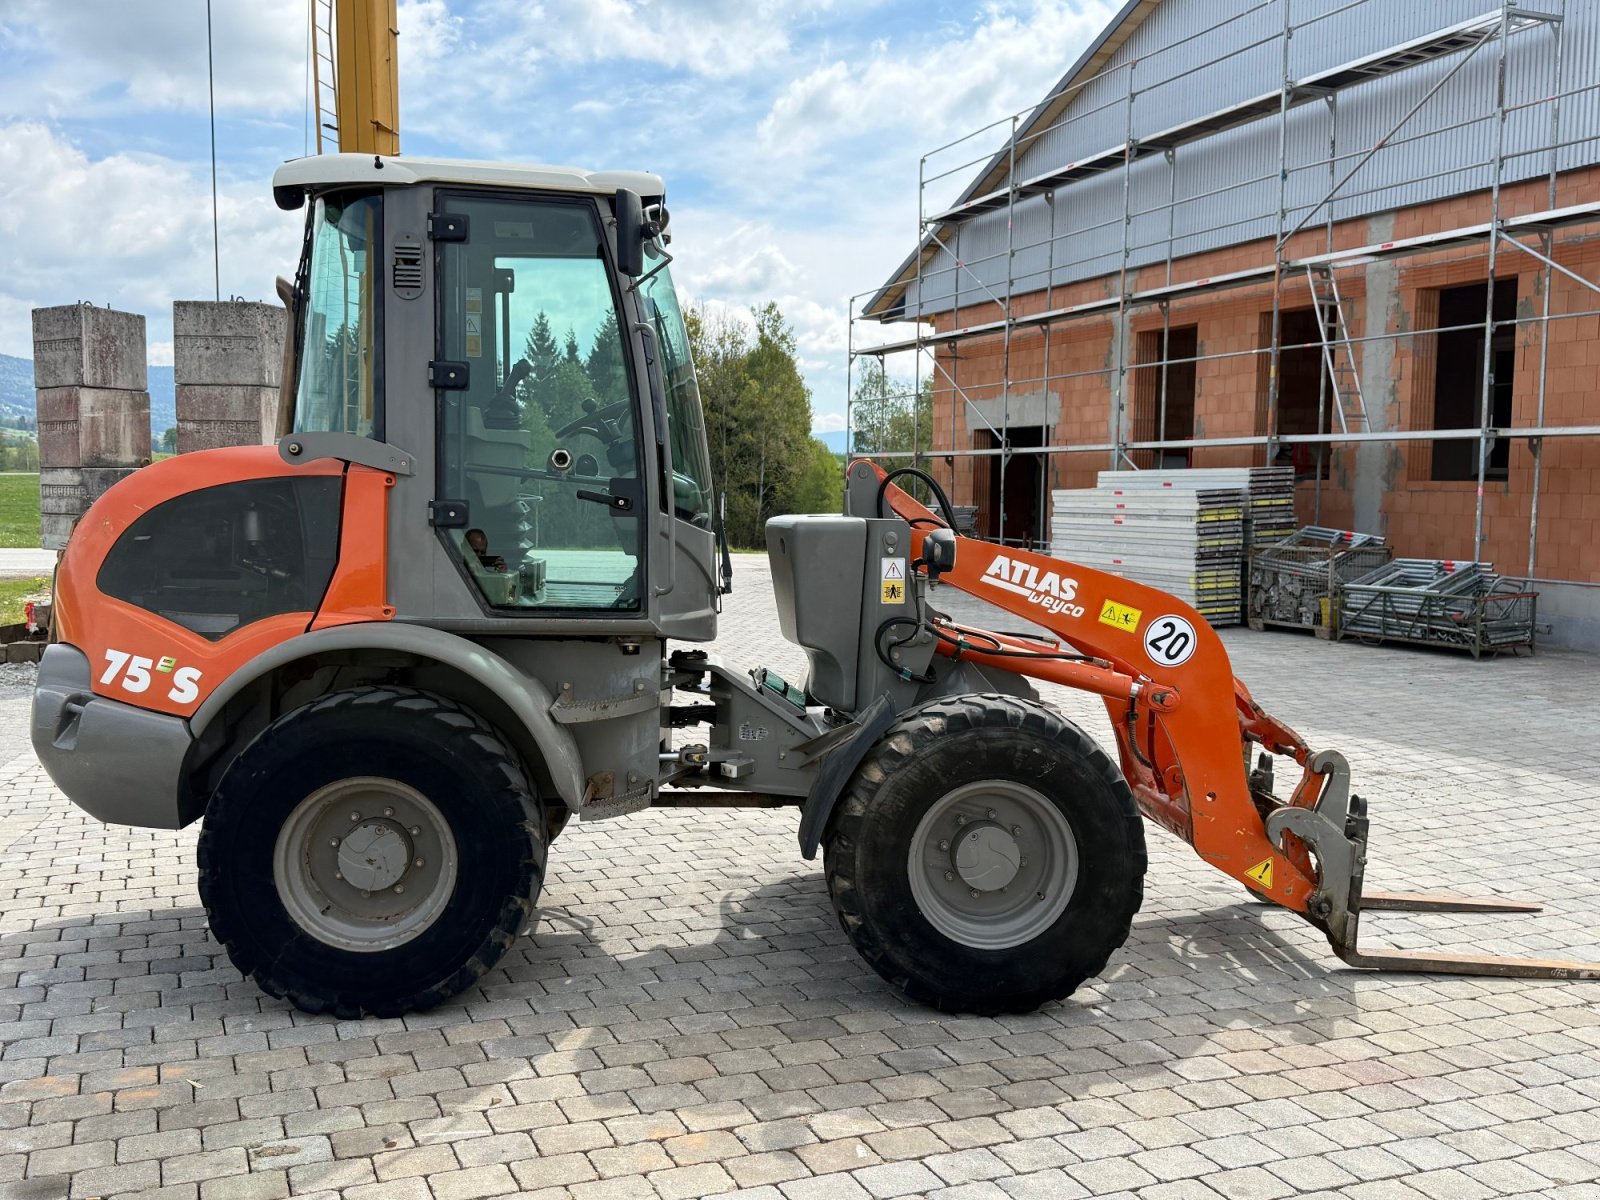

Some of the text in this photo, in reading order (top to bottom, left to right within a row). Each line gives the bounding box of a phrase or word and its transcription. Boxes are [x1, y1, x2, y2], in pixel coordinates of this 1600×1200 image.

[985, 554, 1079, 601] ATLAS
[1028, 591, 1085, 618] weyco
[1148, 621, 1190, 661] 20
